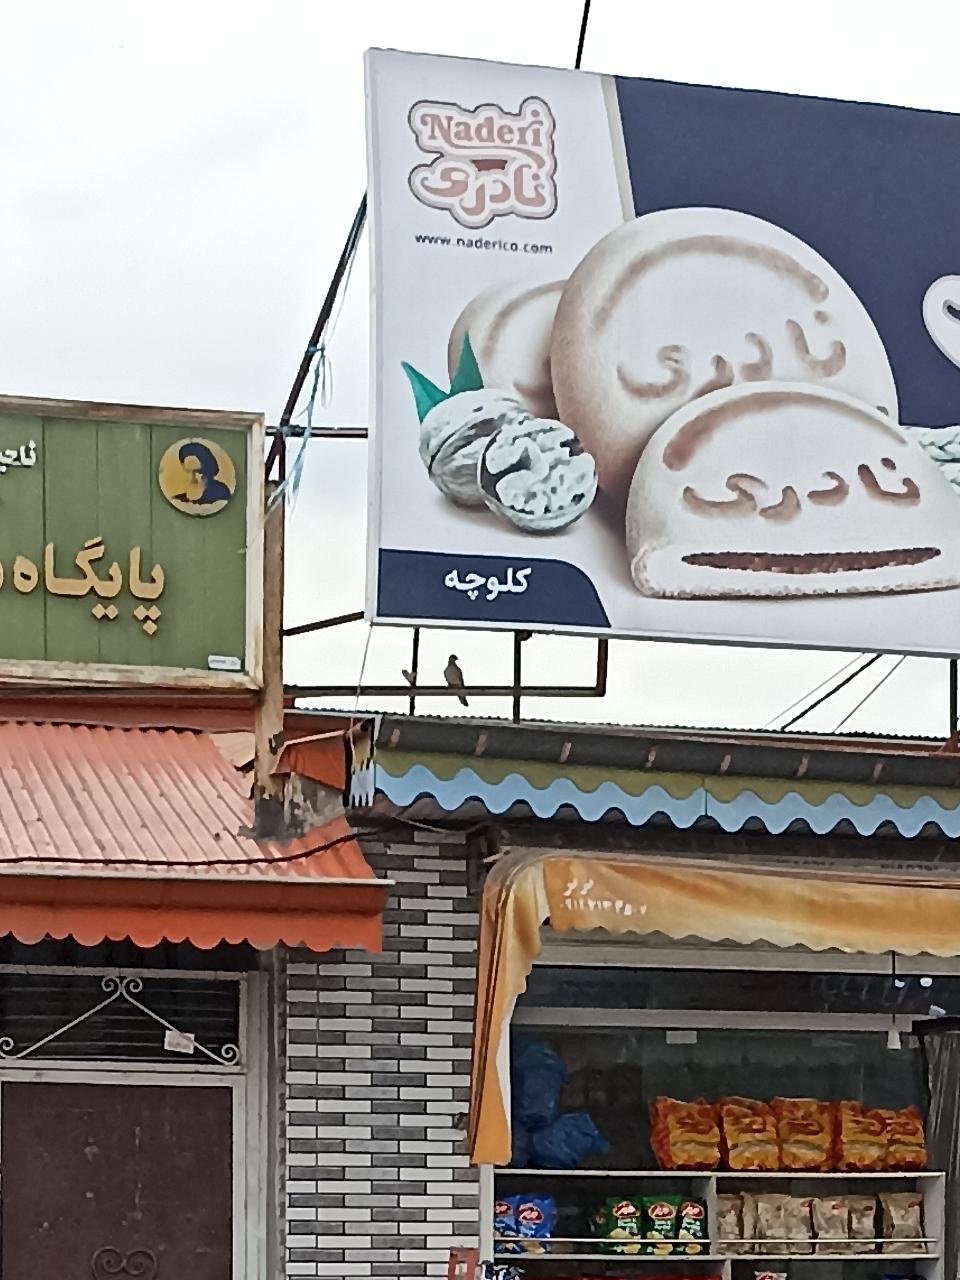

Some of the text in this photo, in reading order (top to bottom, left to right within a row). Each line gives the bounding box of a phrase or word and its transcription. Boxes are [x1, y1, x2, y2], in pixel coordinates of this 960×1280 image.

[420, 109, 545, 164] Naderi
[420, 164, 547, 217] نادری
[414, 234, 553, 255] www.naderico.com
[681, 456, 922, 523] نادری
[13, 535, 166, 636] پایگاه
[444, 565, 532, 603] کلوچه
